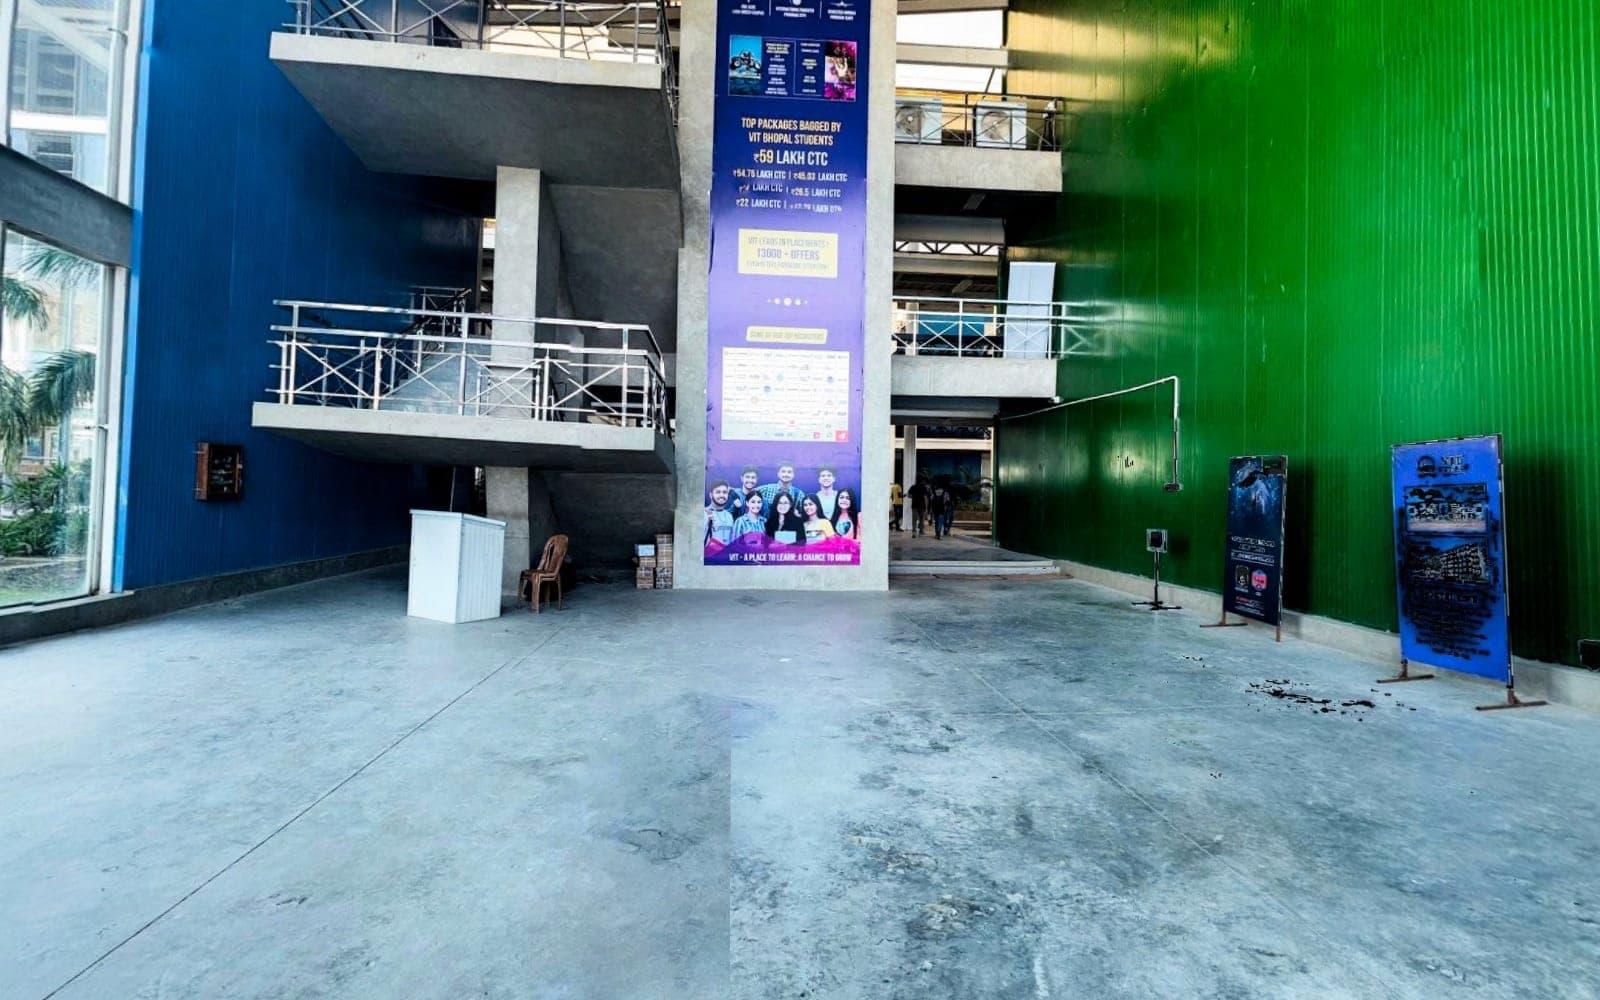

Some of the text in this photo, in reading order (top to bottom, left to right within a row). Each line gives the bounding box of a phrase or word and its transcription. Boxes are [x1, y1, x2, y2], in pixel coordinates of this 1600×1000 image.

[741, 117, 841, 132] TOP PACKAGES BAGGED BY
[748, 132, 833, 146] VIT BHOPAL STUDENTS
[776, 149, 805, 165] LAKH
[807, 151, 828, 166] CTC
[756, 169, 773, 179] LAKH
[774, 171, 786, 180] CTC
[818, 172, 835, 182] LAKH
[835, 173, 848, 182] CTC
[811, 188, 828, 197] LAKH
[828, 188, 841, 198] CTC
[751, 198, 768, 208] LAKH
[769, 199, 782, 209] CTC
[790, 249, 821, 261] OFFERS
[728, 553, 739, 562] VIT
[743, 553, 748, 562] A
[749, 553, 767, 562] PLACE
[768, 553, 776, 562] TO
[803, 553, 826, 562] CHANCE
[827, 553, 835, 562] TO
[835, 553, 852, 562] GROW
